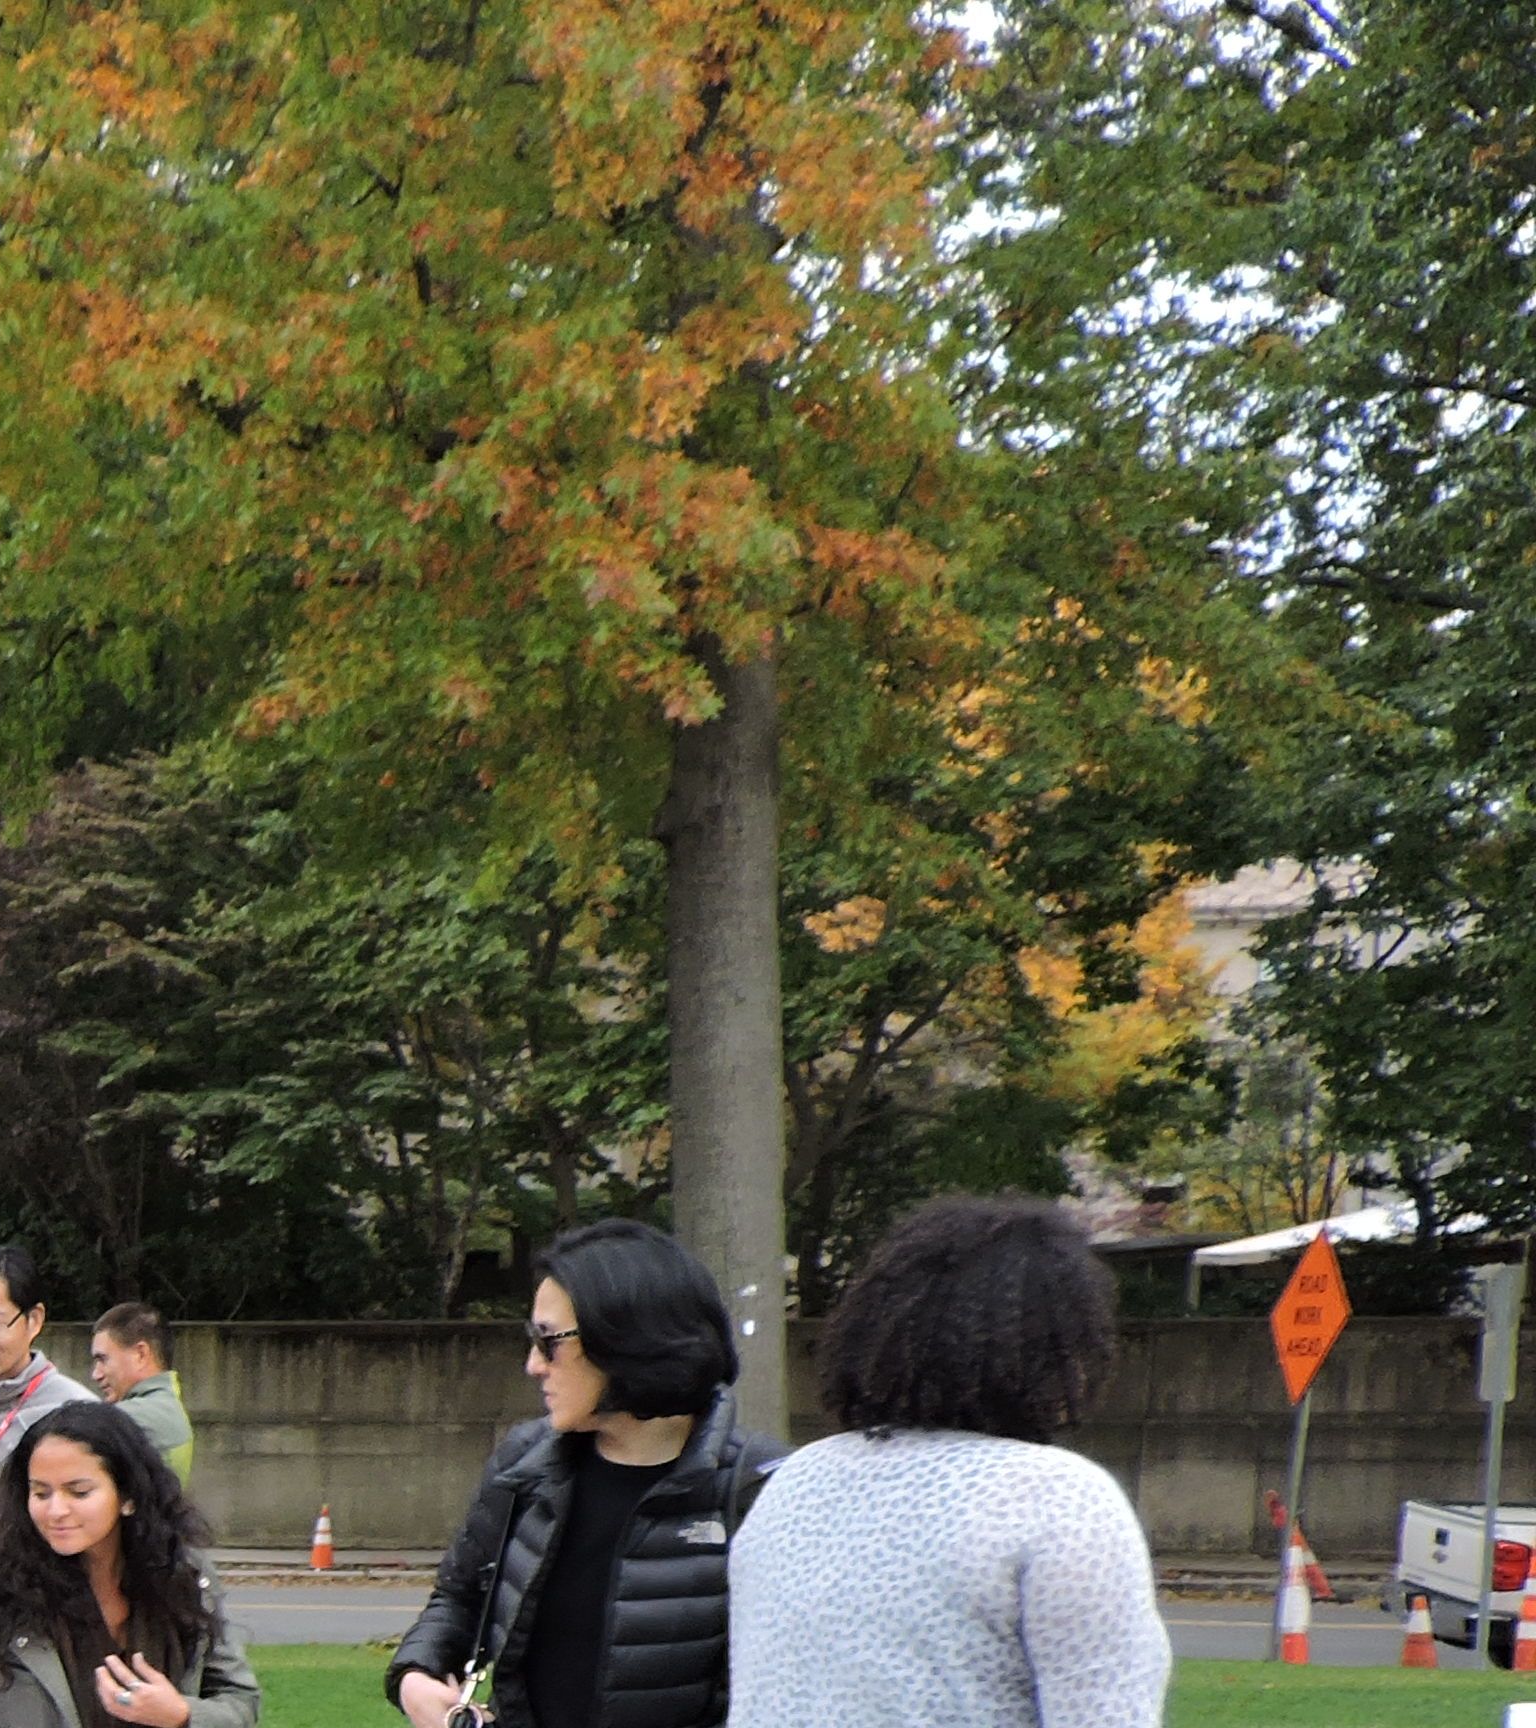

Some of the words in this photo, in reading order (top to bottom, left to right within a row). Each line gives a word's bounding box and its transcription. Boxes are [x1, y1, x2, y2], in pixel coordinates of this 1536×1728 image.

[1299, 1274, 1328, 1293] ROAD
[1294, 1306, 1323, 1326] WORK
[1287, 1337, 1322, 1356] AHEAD
